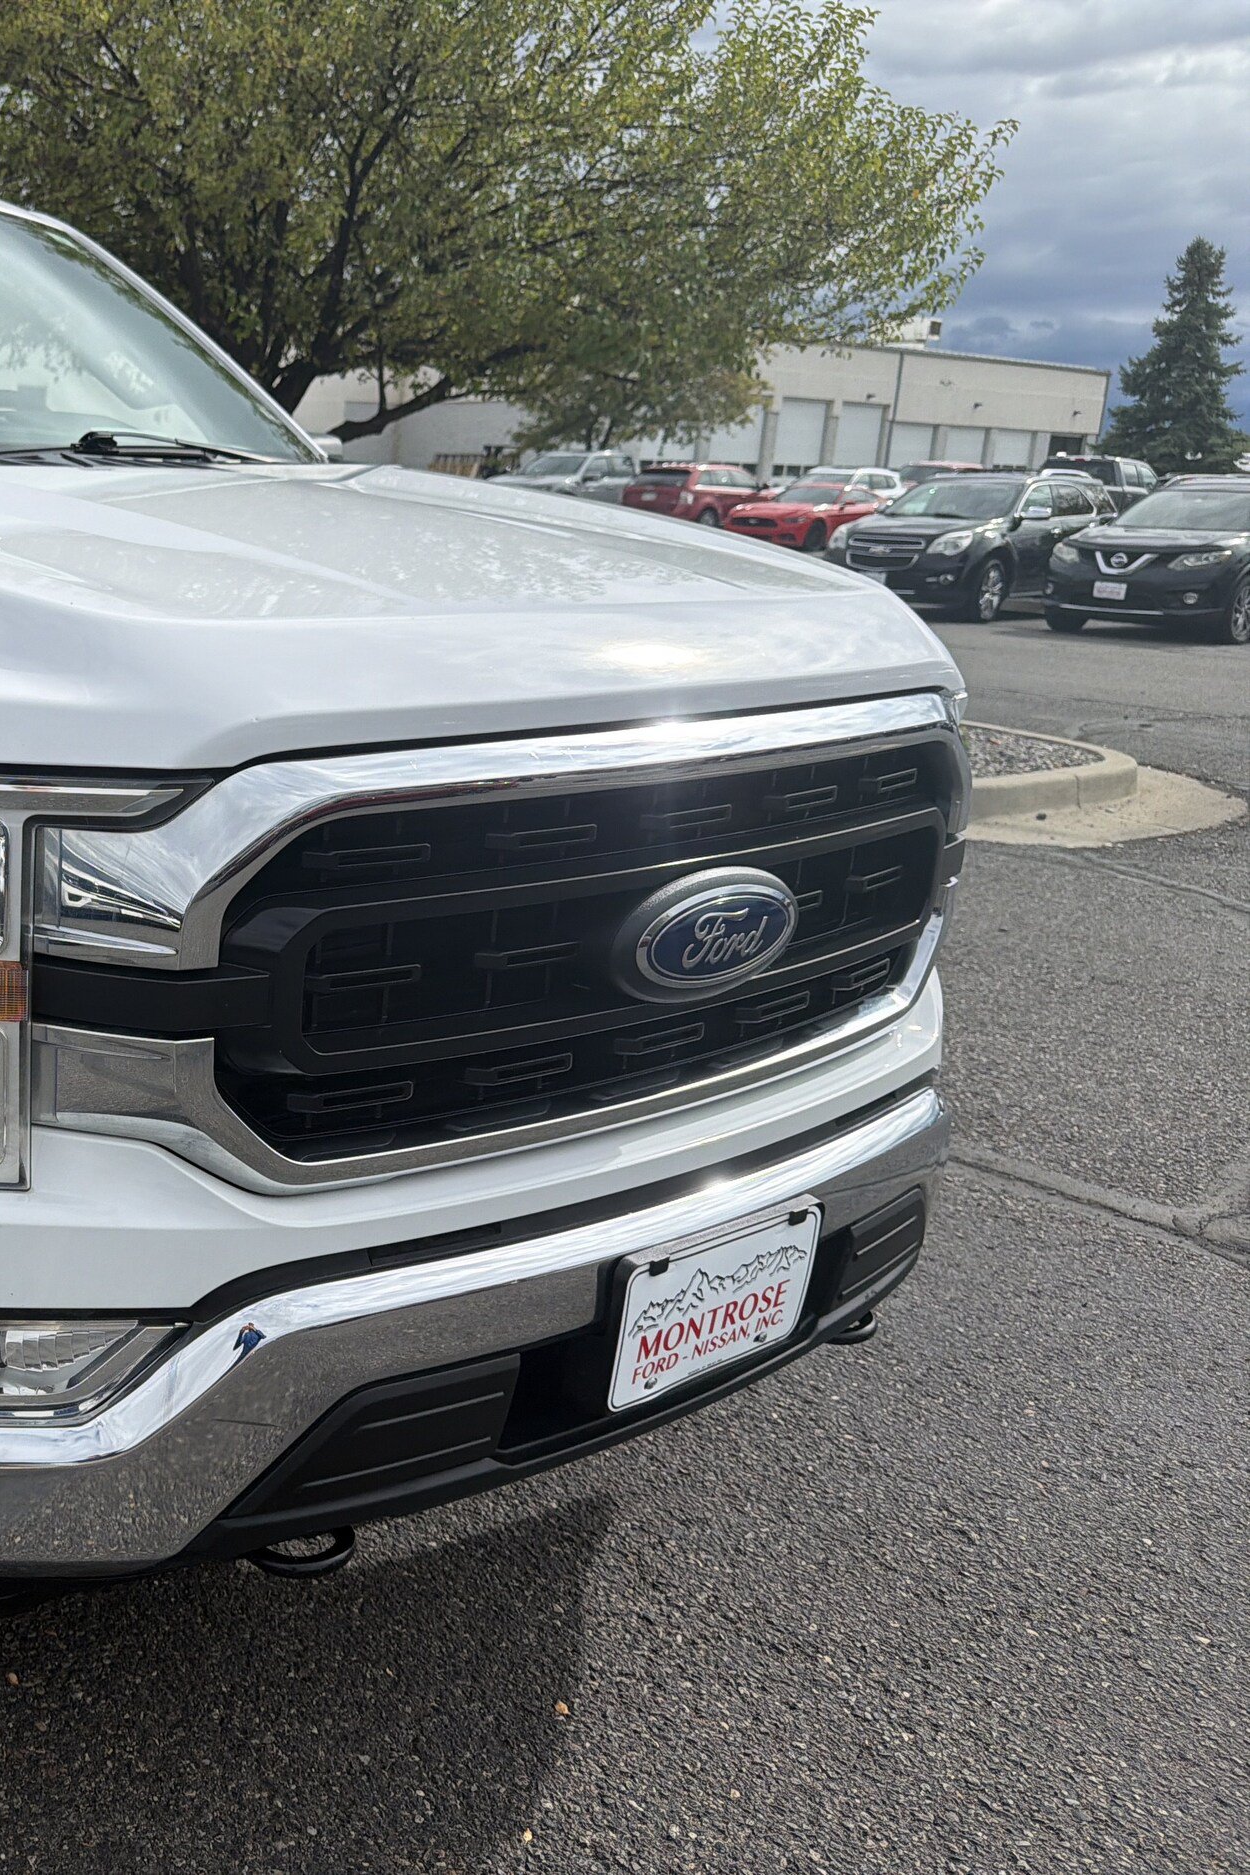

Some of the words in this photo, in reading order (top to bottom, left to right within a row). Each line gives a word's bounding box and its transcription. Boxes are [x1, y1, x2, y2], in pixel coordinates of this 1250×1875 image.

[681, 907, 768, 970] Ford
[631, 1352, 679, 1385] FORD
[691, 1322, 750, 1360] NISSAN,
[754, 1309, 784, 1333] INC.
[636, 1279, 791, 1363] MONTROSE
